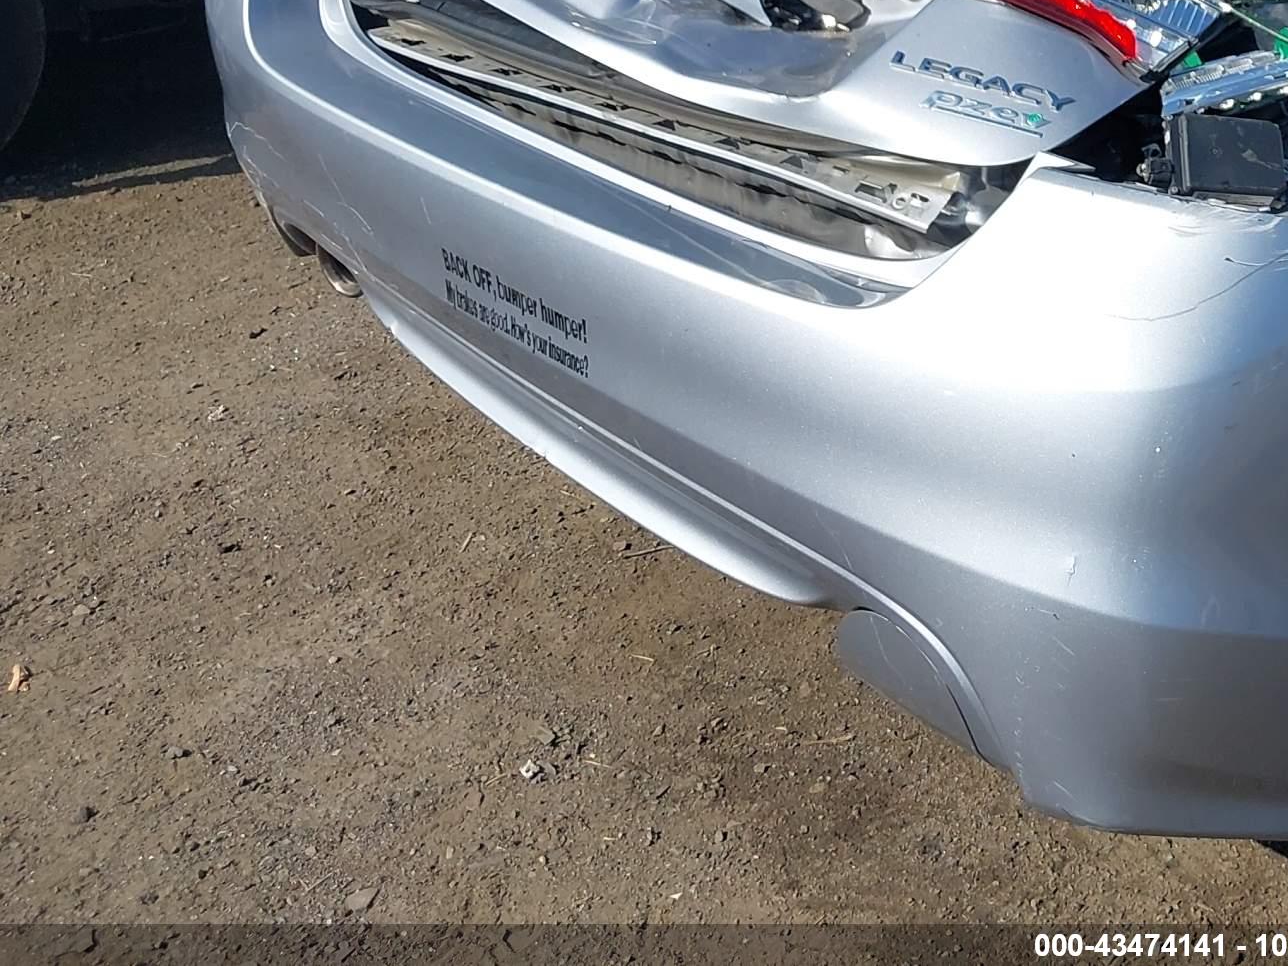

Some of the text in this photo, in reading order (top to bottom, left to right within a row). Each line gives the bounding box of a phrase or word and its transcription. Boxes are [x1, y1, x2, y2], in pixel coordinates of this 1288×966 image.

[889, 49, 1077, 113] LEGACY
[441, 247, 588, 344] BACK OFF, bumper humper!
[455, 284, 479, 319] brakes
[479, 303, 490, 326] are
[531, 331, 548, 354] your
[547, 334, 590, 379] insurance?
